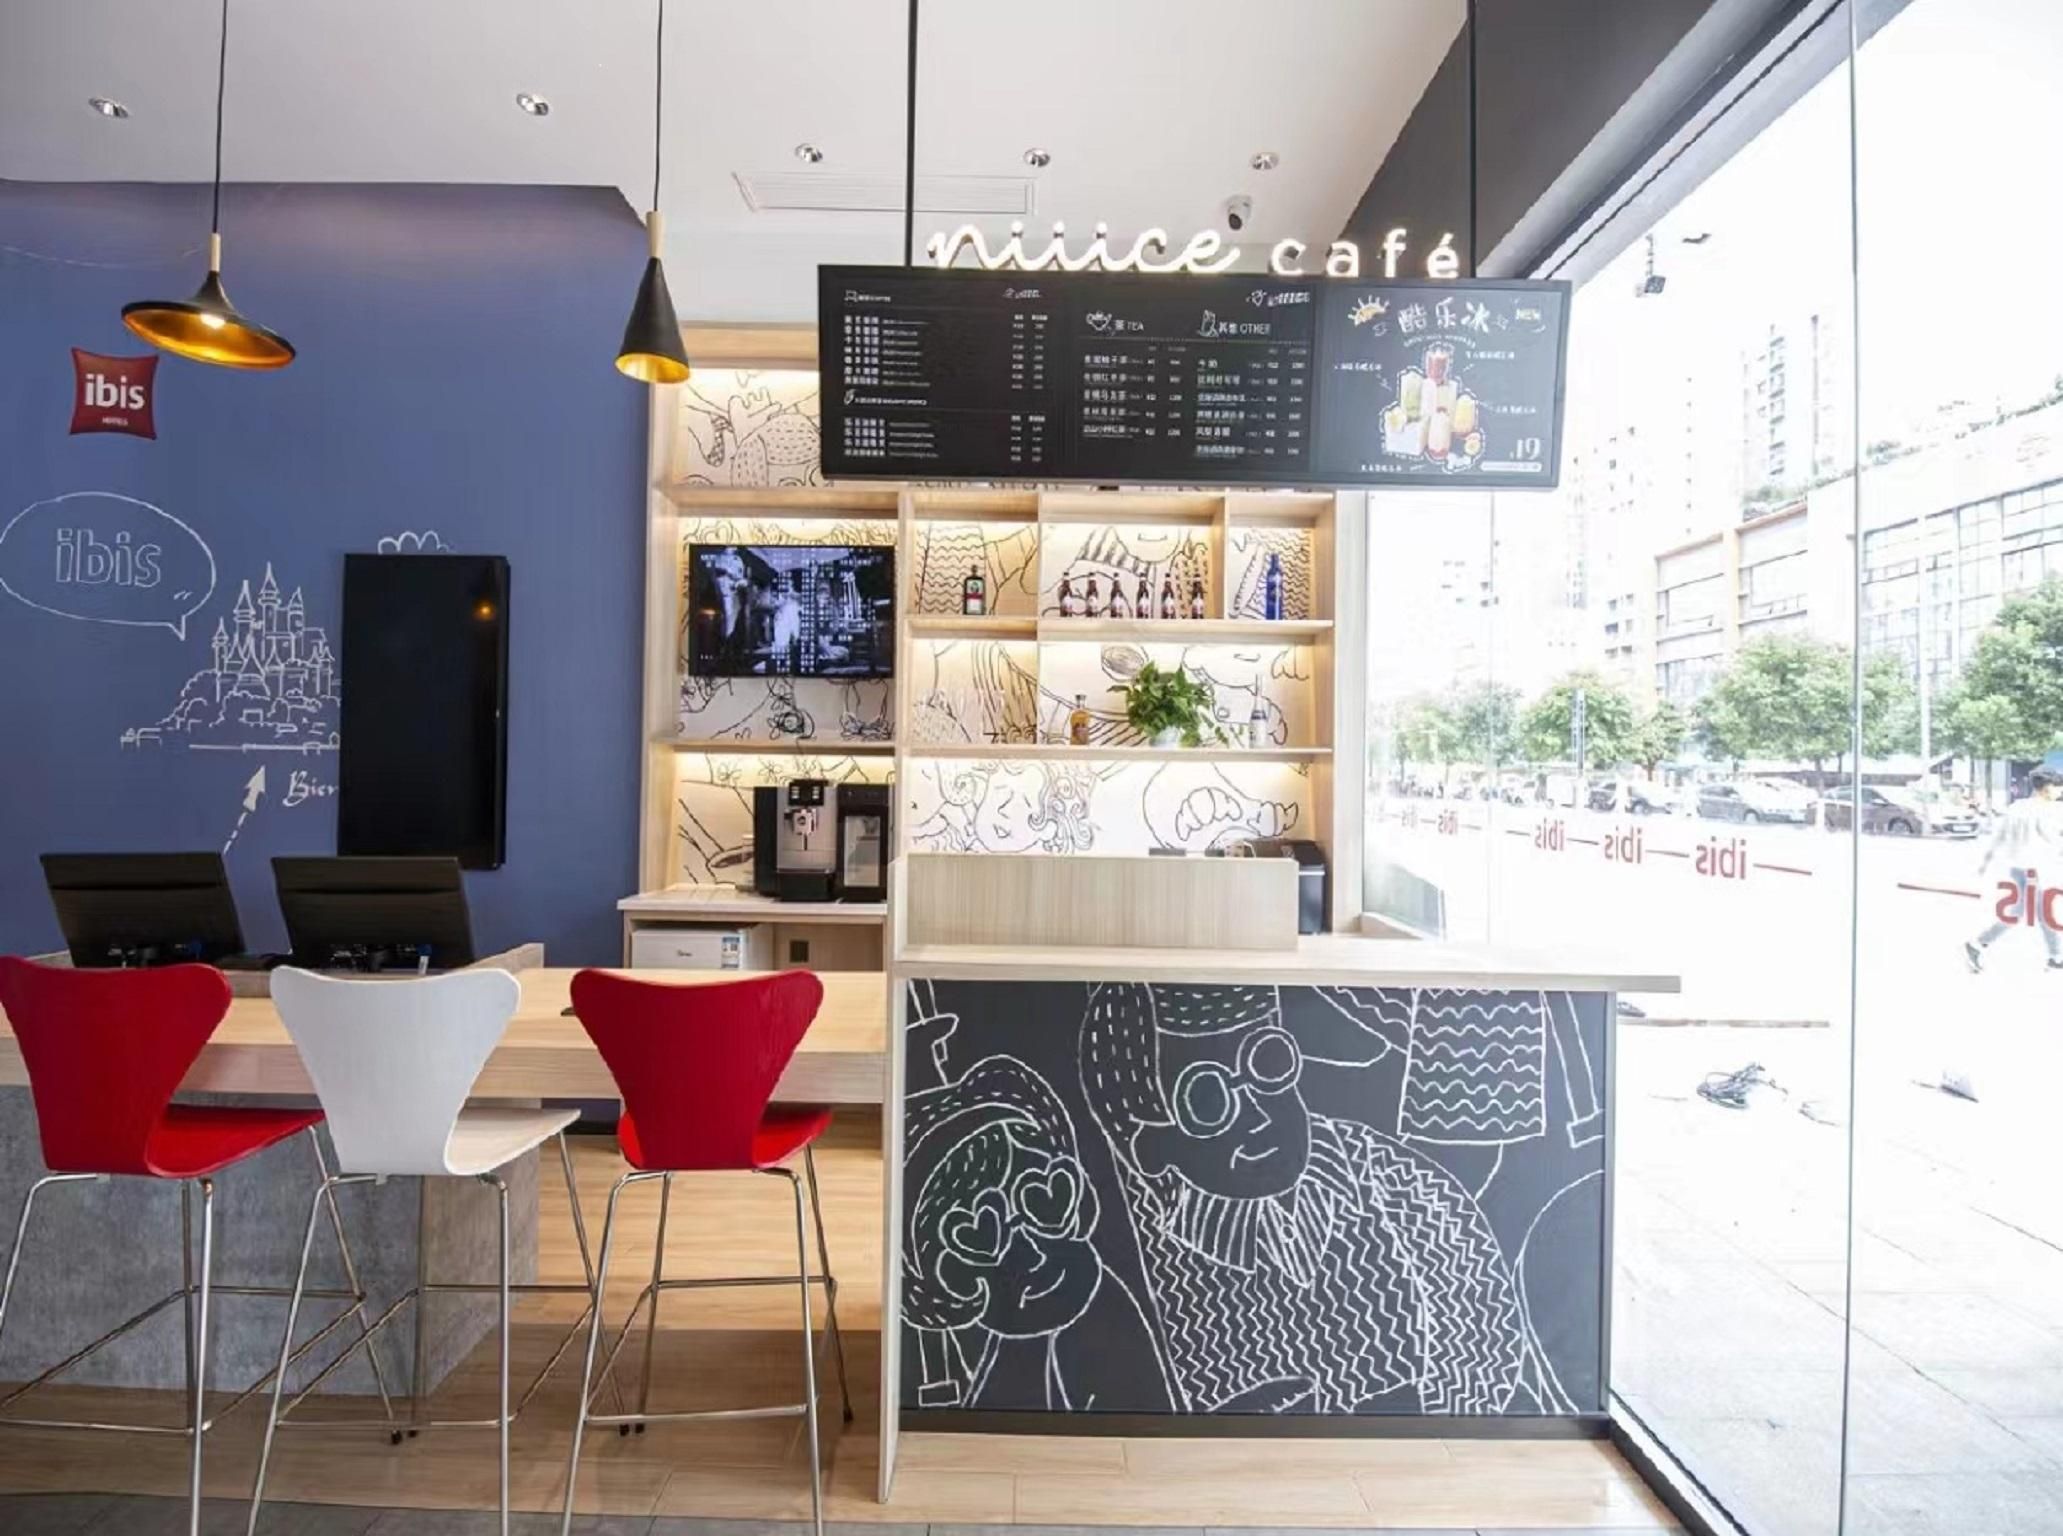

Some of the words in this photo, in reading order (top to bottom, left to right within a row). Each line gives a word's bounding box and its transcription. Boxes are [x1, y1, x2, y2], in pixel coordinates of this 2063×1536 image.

[1270, 231, 1461, 277] café
[1127, 320, 1145, 332] TEA
[1239, 322, 1272, 335] OTHER
[84, 373, 145, 410] ibis
[55, 527, 162, 588] ibis
